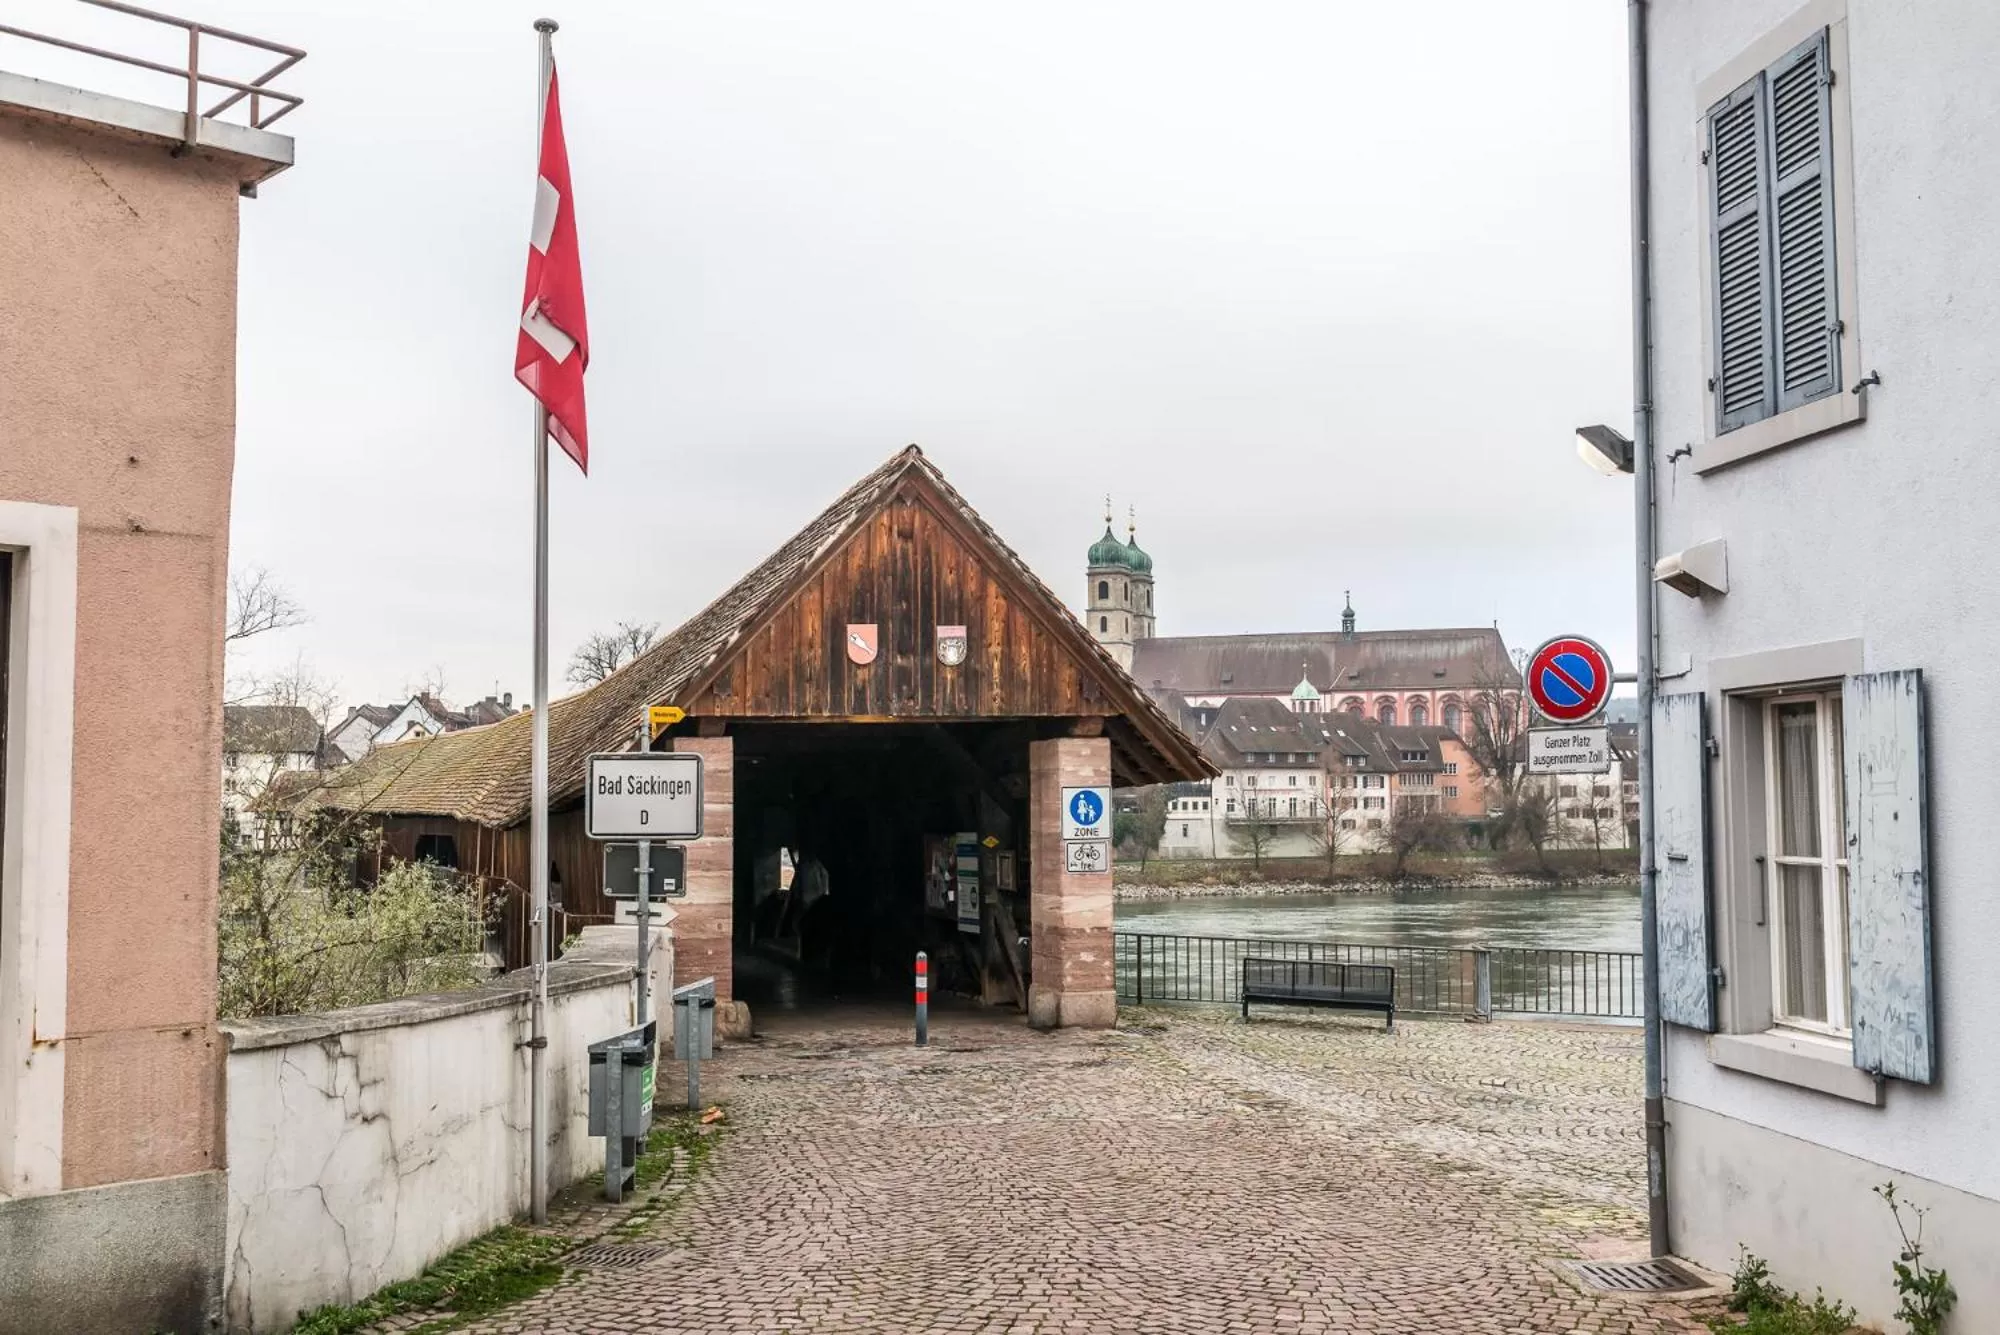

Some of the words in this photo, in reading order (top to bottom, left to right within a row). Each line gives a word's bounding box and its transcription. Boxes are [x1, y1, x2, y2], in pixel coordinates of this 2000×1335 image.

[1544, 736, 1571, 749] Ganzer
[1572, 734, 1591, 747] Platz
[1533, 754, 1587, 768] ausgenommen
[1588, 750, 1604, 763] Zoll
[599, 776, 622, 795] Bad
[628, 775, 691, 800] Säckingen
[640, 810, 649, 825] D
[1074, 827, 1100, 837] ZONE
[1080, 861, 1096, 870] frei
